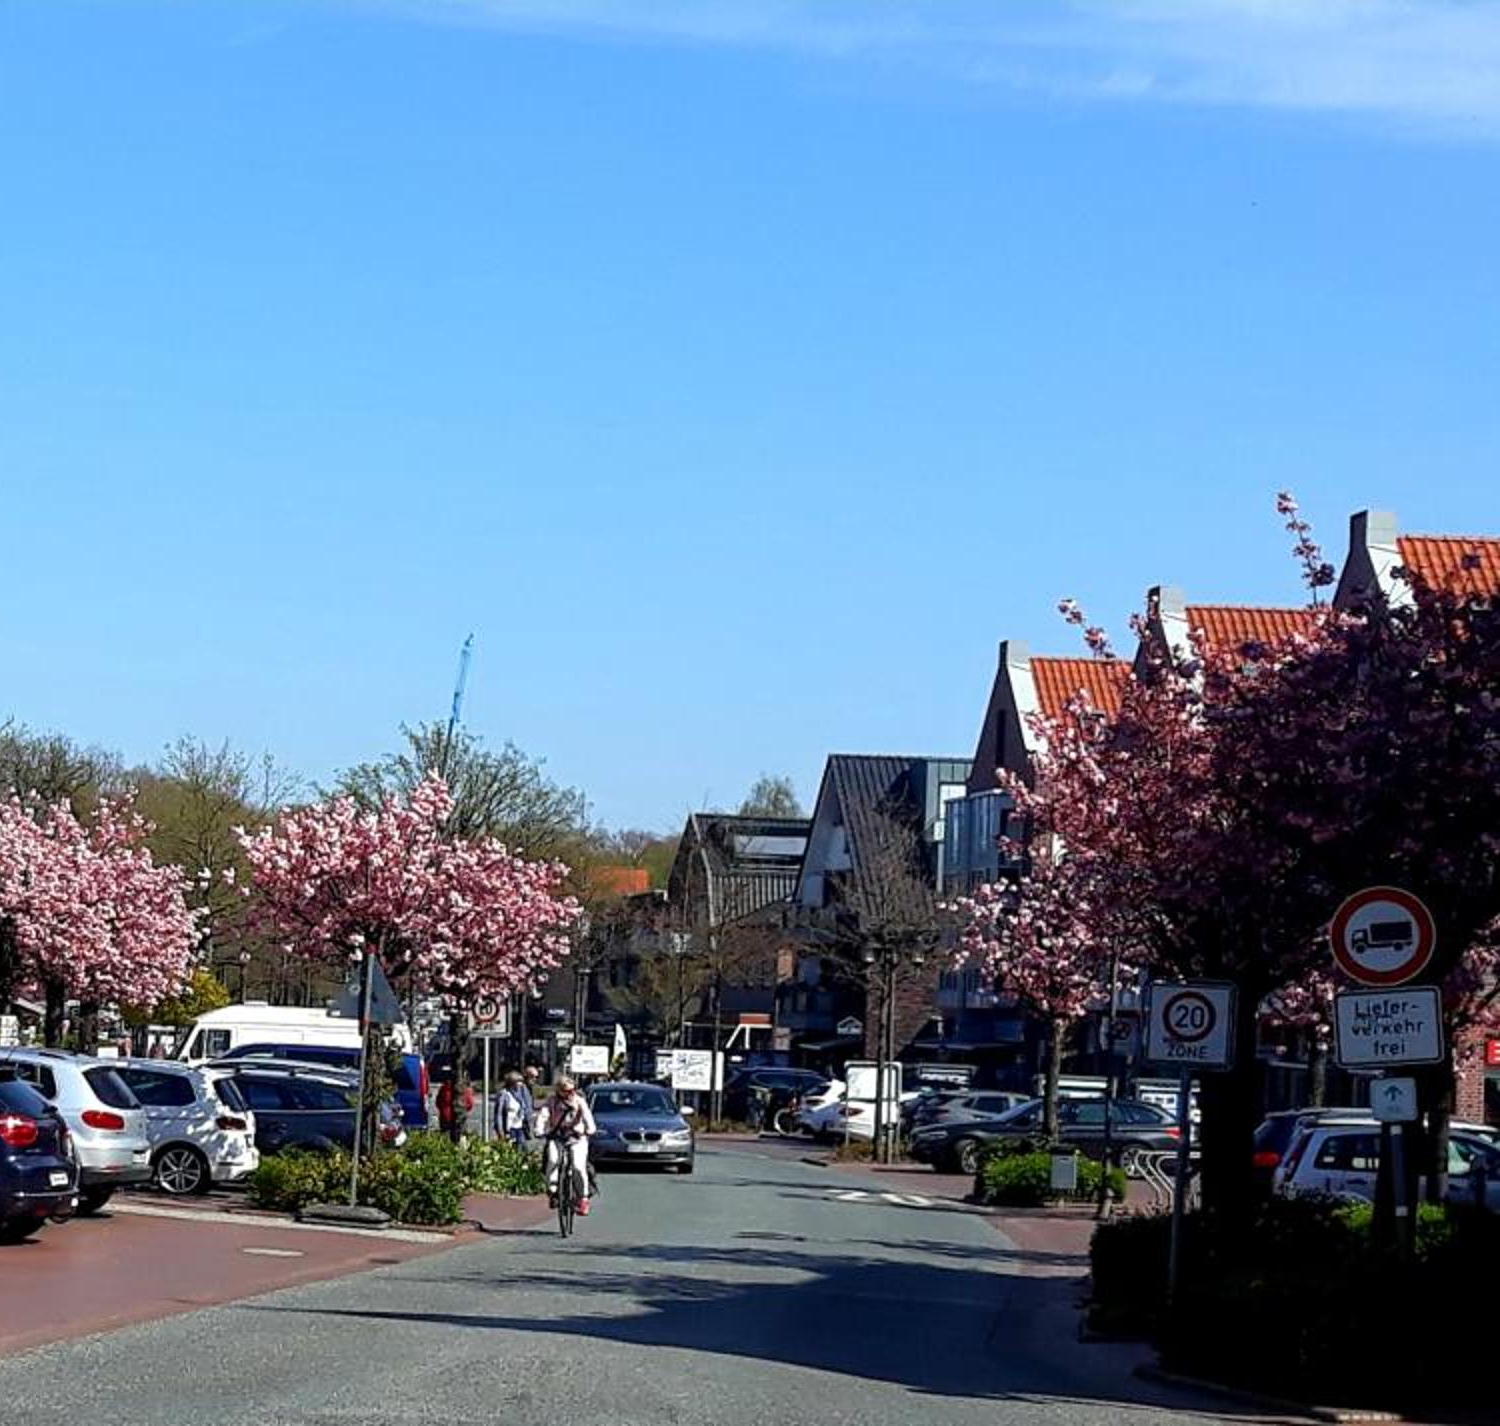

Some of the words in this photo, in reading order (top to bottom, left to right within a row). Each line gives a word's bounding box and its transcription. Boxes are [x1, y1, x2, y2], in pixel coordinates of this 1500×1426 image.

[1174, 1004, 1204, 1029] 20
[1355, 1000, 1420, 1018] Liefer-
[1351, 1019, 1424, 1037] verkehr
[1167, 1044, 1208, 1059] ZONE
[1373, 1039, 1406, 1056] frei
